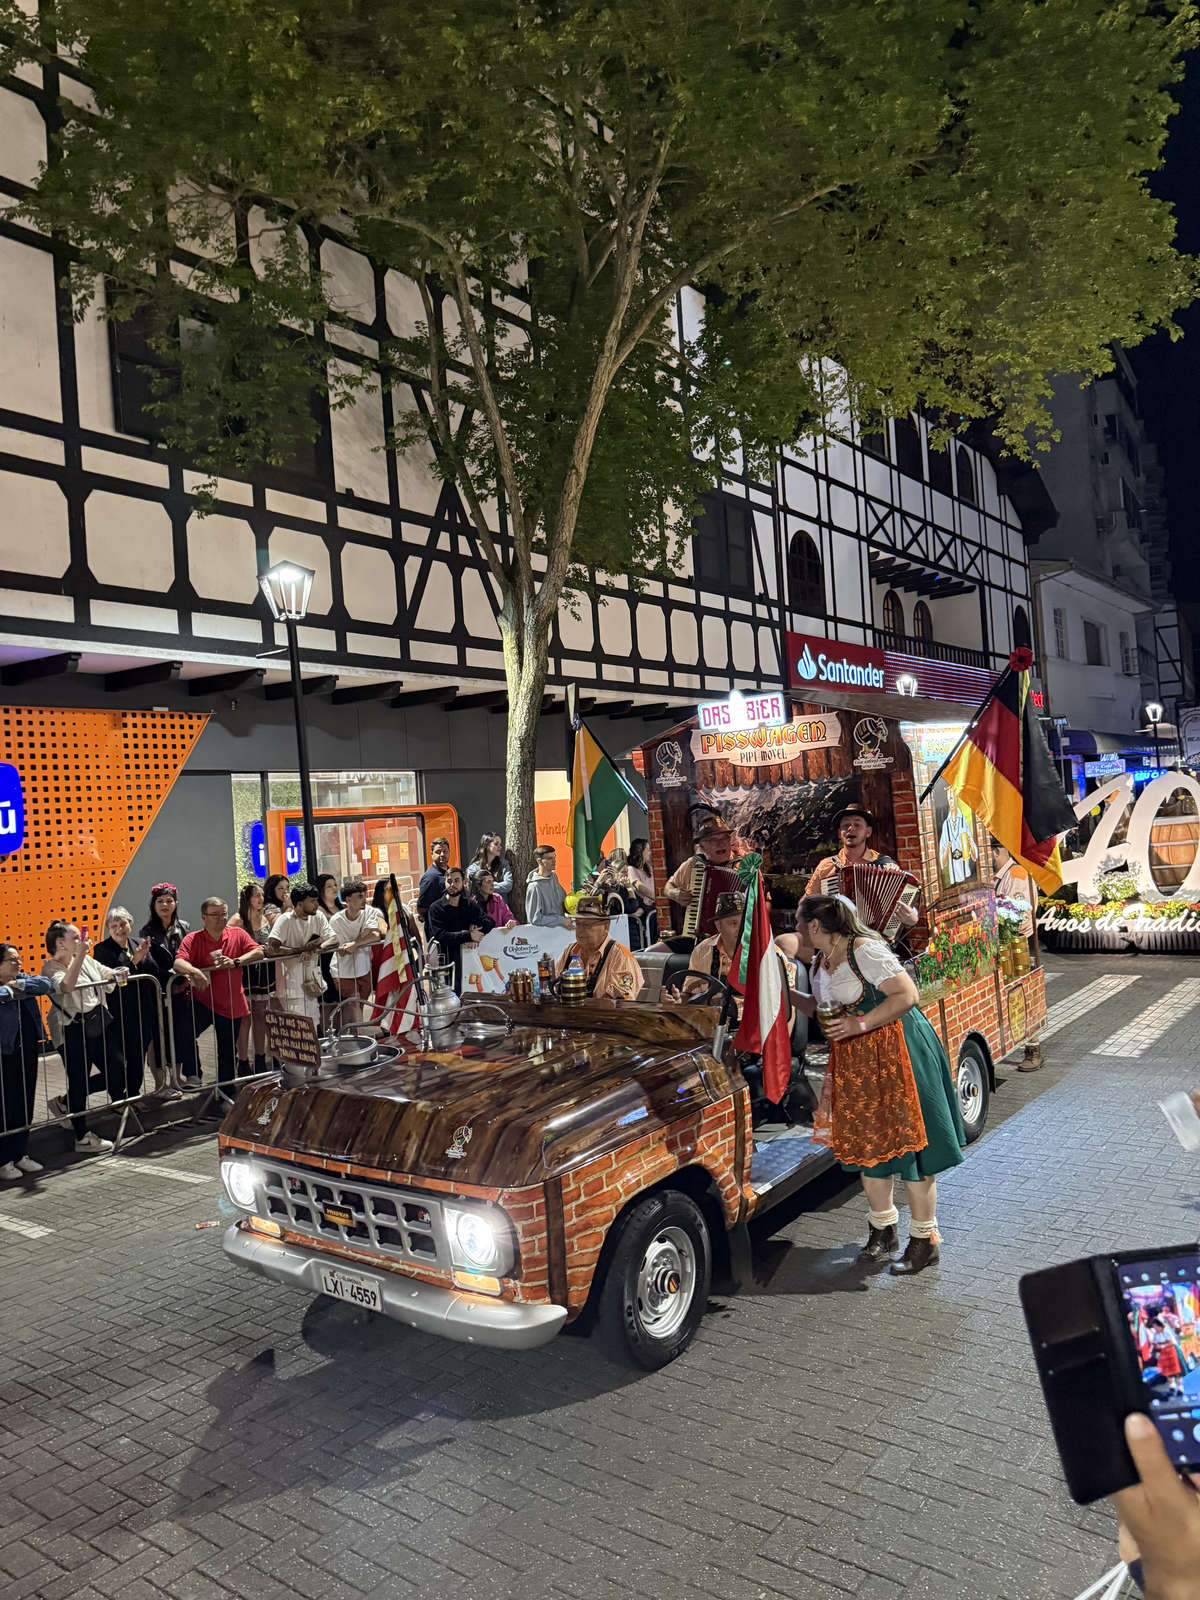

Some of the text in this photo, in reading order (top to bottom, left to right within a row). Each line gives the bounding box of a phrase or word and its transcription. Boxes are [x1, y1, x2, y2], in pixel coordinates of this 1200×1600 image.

[817, 652, 884, 689] Santander
[702, 704, 731, 727] DAS
[701, 720, 827, 754] PISSWAGEN
[1037, 906, 1092, 933] Anos
[1095, 910, 1126, 932] de
